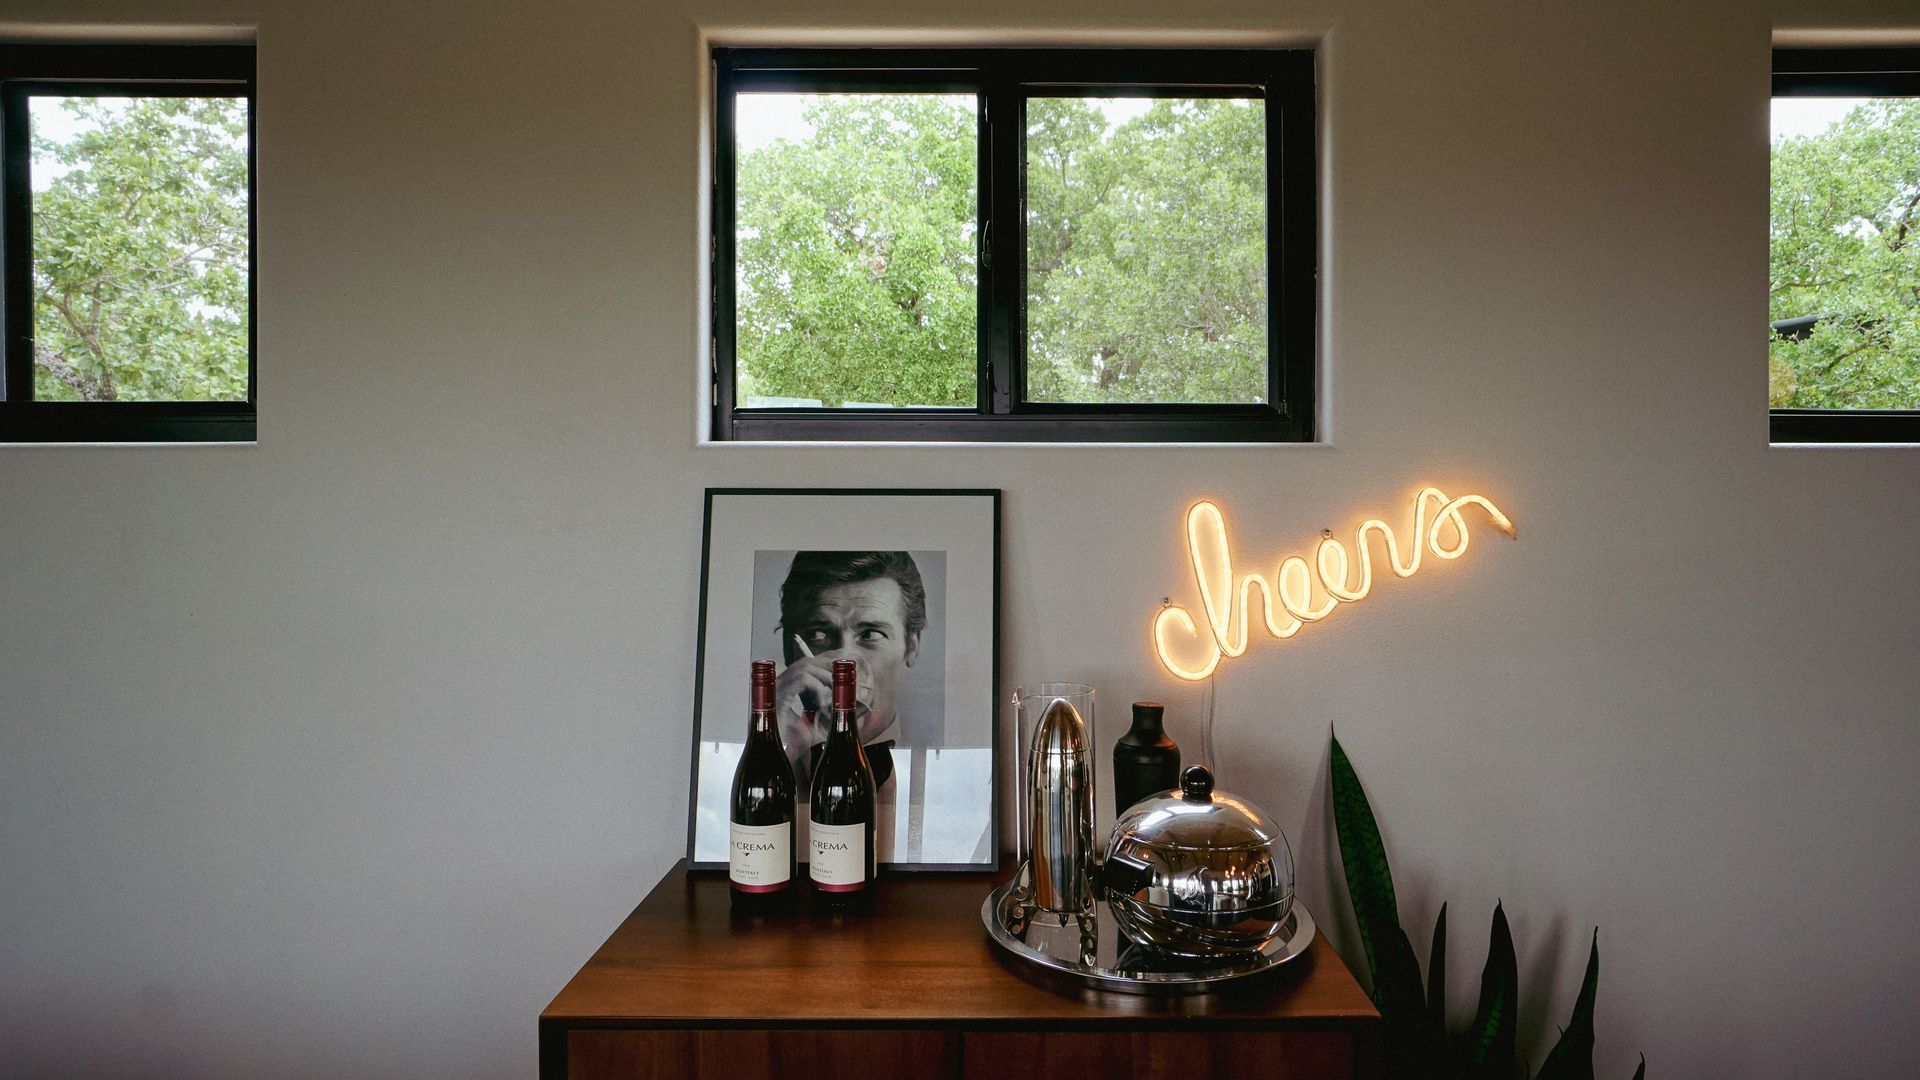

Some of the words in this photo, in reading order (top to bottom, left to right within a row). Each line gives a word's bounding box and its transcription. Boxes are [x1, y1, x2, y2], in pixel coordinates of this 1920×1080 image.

[1155, 487, 1515, 681] cheers
[736, 841, 775, 851] CREMA
[812, 840, 848, 850] CREMA
